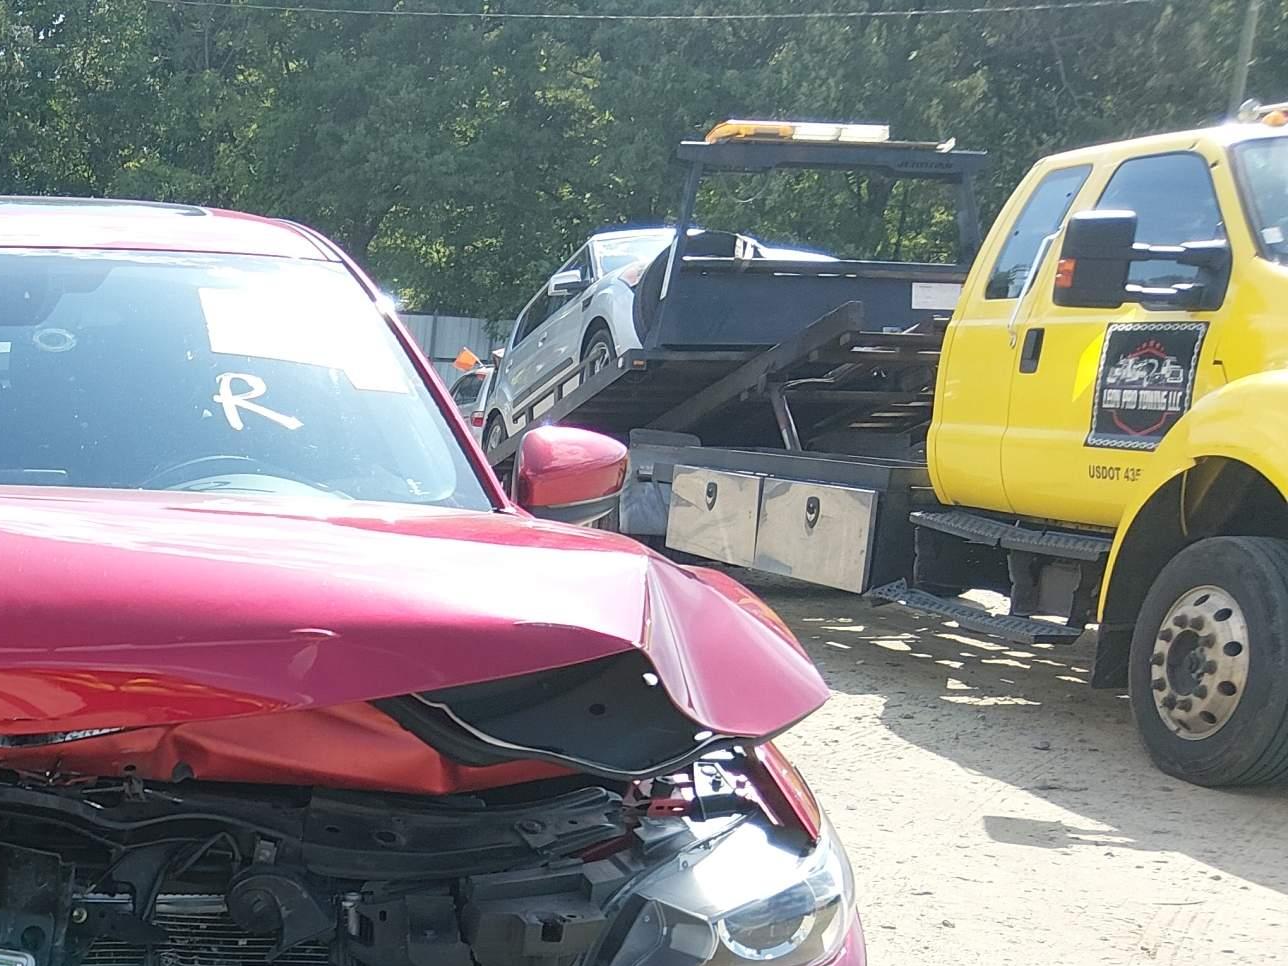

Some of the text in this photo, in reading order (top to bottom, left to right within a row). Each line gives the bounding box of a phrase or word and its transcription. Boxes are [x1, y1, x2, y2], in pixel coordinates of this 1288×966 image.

[213, 371, 304, 432] R
[1168, 390, 1183, 412] LLC
[1088, 464, 1121, 481] USDOT
